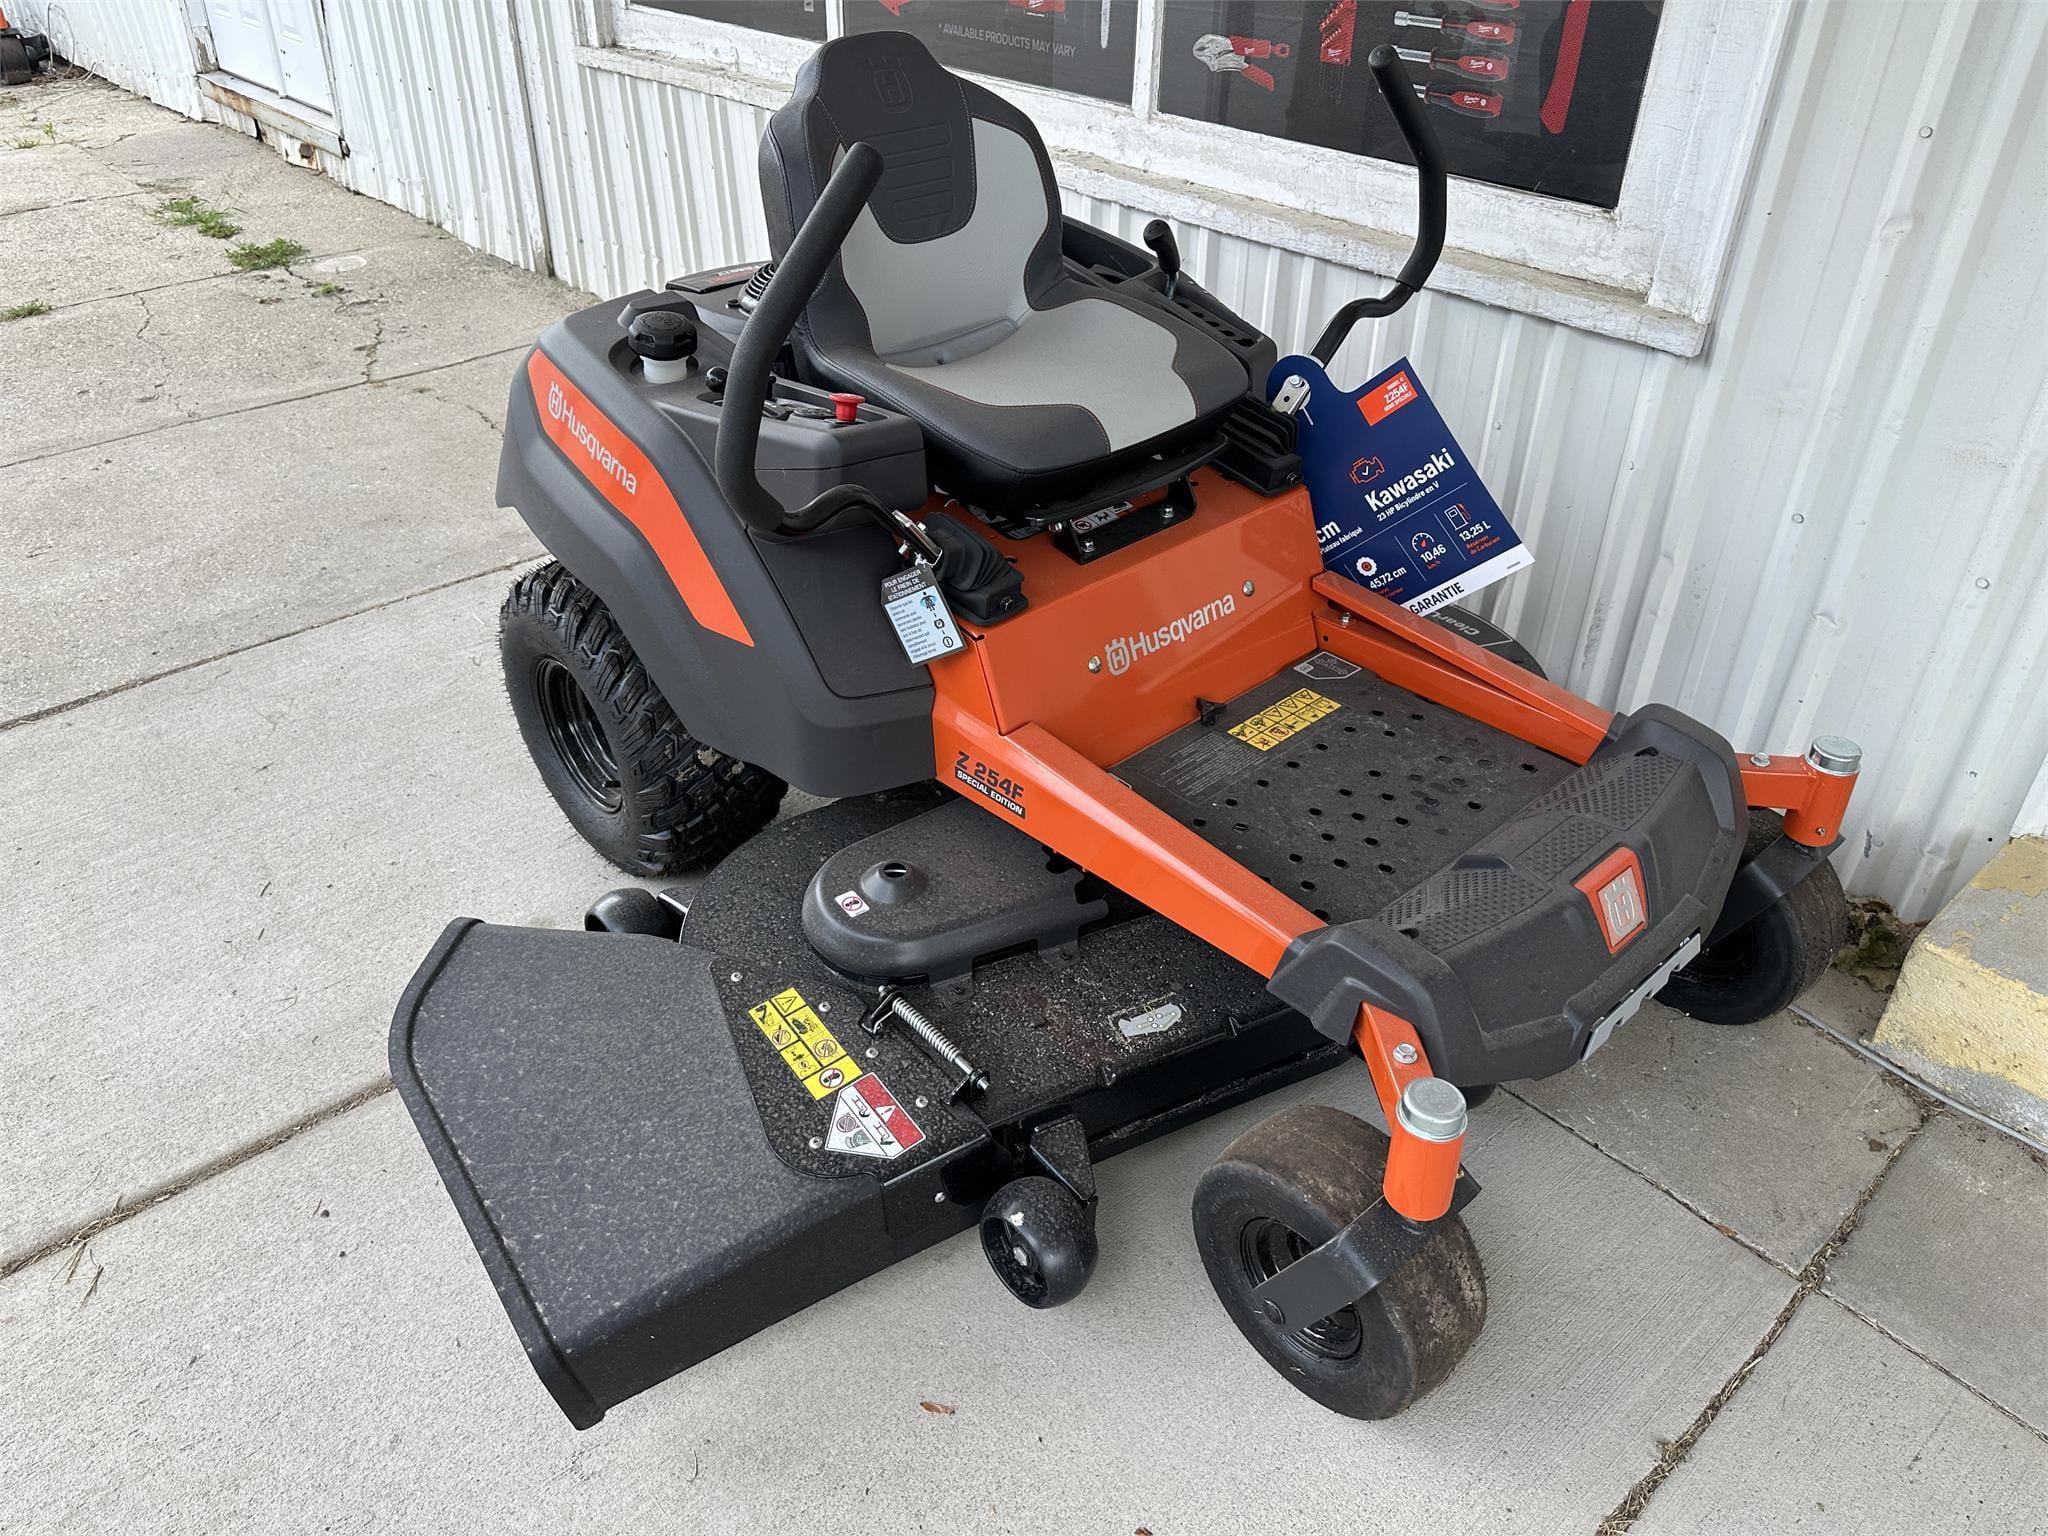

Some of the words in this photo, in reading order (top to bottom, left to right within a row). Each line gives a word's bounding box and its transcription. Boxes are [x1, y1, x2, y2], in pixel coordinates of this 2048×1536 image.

[985, 30, 1031, 49] PRODUCTS
[1031, 39, 1052, 53] MAY
[1052, 43, 1076, 58] VARY
[1383, 382, 1408, 404] Z254F
[561, 399, 637, 496] Husqvarna
[1364, 447, 1455, 512] Kawasaki
[1376, 512, 1387, 522] 23
[1385, 506, 1395, 517] HP
[1394, 491, 1426, 511] Bicylindre
[1425, 485, 1435, 494] en
[1432, 480, 1440, 489] V
[1316, 521, 1342, 543] cm
[1459, 523, 1484, 542] 13,25
[1481, 520, 1492, 530] L
[1420, 543, 1447, 563] 10,46
[884, 578, 899, 588] POUR
[897, 569, 922, 583] ENGAGER
[896, 580, 912, 590] FREIN
[911, 577, 920, 585] DE
[1369, 572, 1394, 589] 45,72
[1392, 566, 1408, 578] cm
[1409, 582, 1465, 615] GARANTIE
[1128, 593, 1236, 662] Husqvarna
[956, 750, 970, 770] Z
[974, 761, 1024, 800] 254F
[957, 770, 989, 795] SPECIAL
[990, 791, 1023, 815] EDITION
